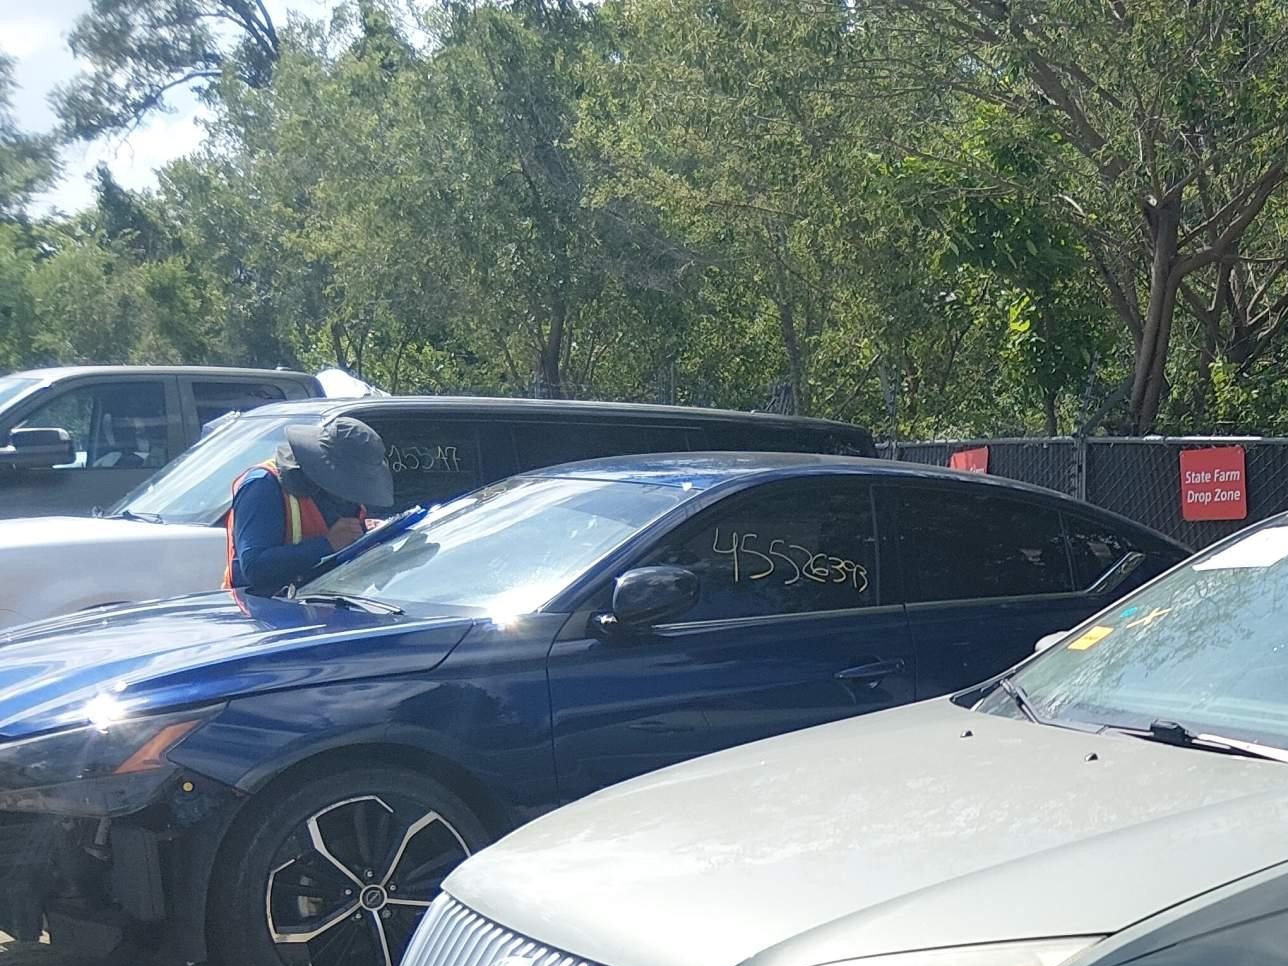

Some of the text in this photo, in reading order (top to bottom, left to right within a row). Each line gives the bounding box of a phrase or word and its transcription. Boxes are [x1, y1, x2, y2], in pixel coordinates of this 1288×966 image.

[1185, 468, 1240, 484] State Farm
[1187, 488, 1241, 505] Drop Zone
